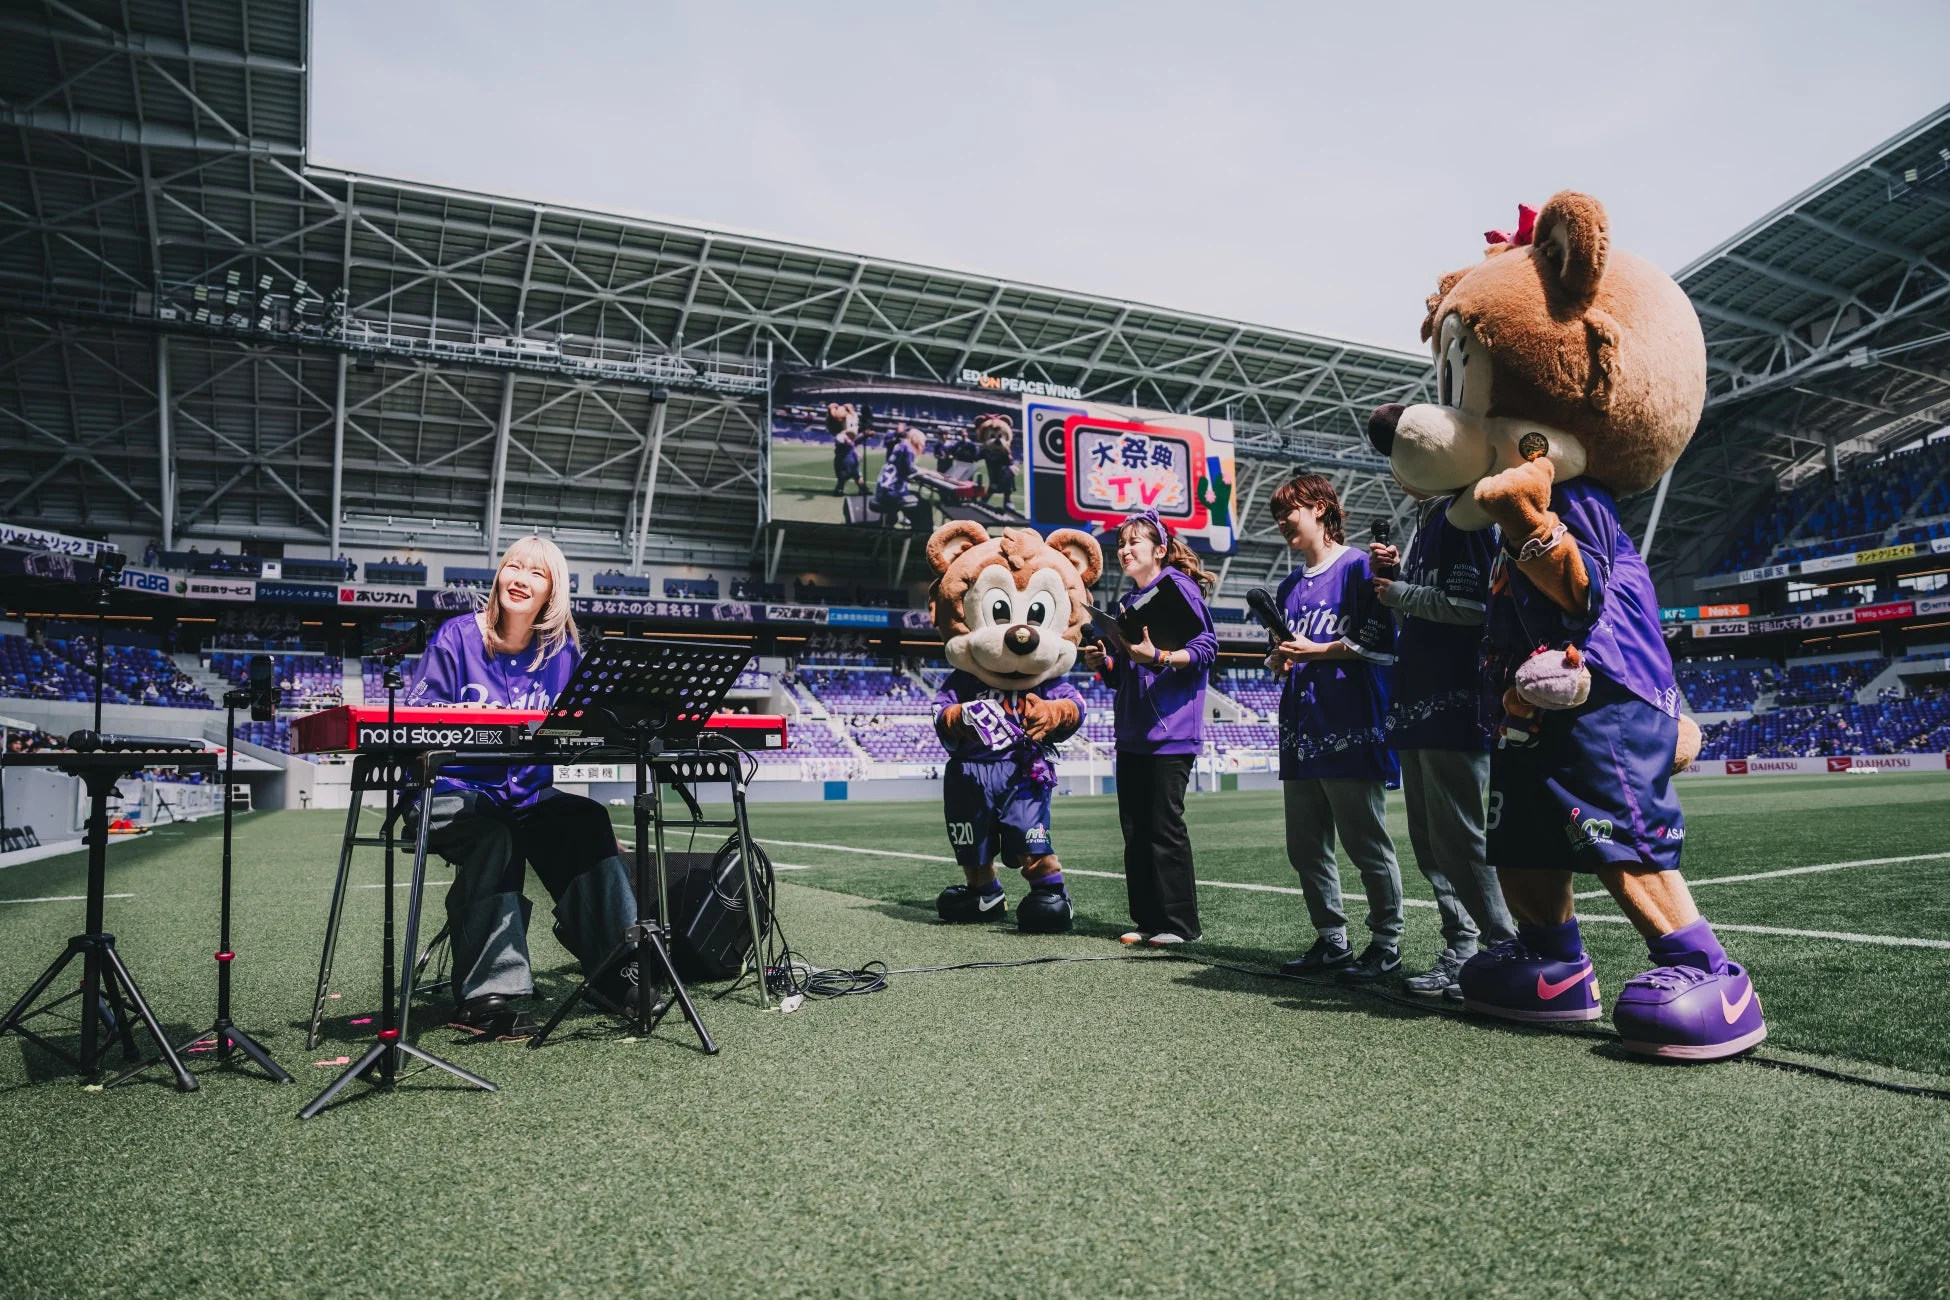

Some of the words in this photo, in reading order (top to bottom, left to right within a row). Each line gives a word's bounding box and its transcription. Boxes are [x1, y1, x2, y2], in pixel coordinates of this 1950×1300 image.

[962, 368, 1001, 389] EDION
[1091, 436, 1173, 470] 大祭典
[1108, 477, 1164, 506] TV
[191, 584, 252, 596] 新日本サービス
[259, 588, 293, 597] クレイトン
[313, 591, 335, 599] ホテル
[356, 590, 414, 604] あじかん
[1664, 609, 1686, 619] KFC
[1708, 606, 1740, 617] Net-X
[1759, 618, 1801, 633] 福山大学
[360, 725, 407, 744] nord
[475, 730, 503, 745] EX
[1750, 762, 1797, 771] DAIHATSU
[1856, 758, 1911, 768] DAIHATSU
[558, 767, 614, 780] 宮本鋼機
[948, 822, 974, 845] 320
